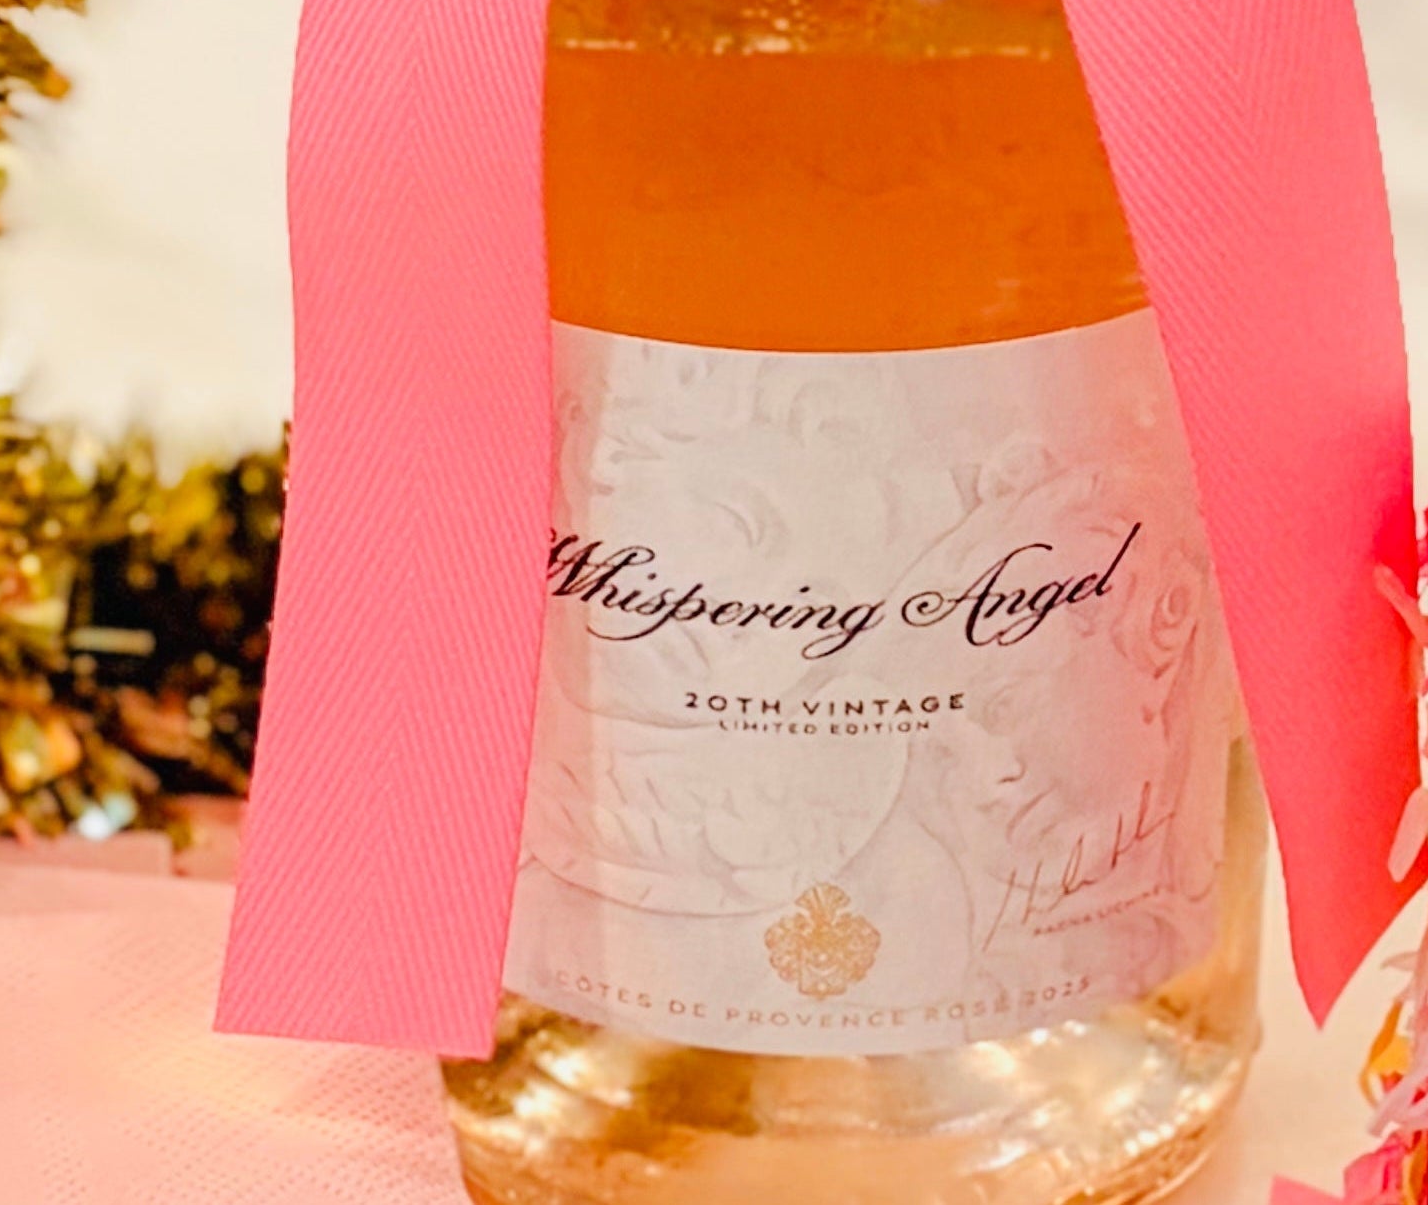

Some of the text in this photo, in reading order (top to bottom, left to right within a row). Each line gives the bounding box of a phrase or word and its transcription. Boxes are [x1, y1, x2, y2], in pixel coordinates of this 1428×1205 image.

[547, 522, 1141, 660] Whispering Angel
[684, 692, 965, 716] 20TH VINTAGE
[718, 720, 930, 735] LIMITED EDITION
[668, 999, 708, 1019] DE
[724, 1007, 904, 1028] PROVENCE
